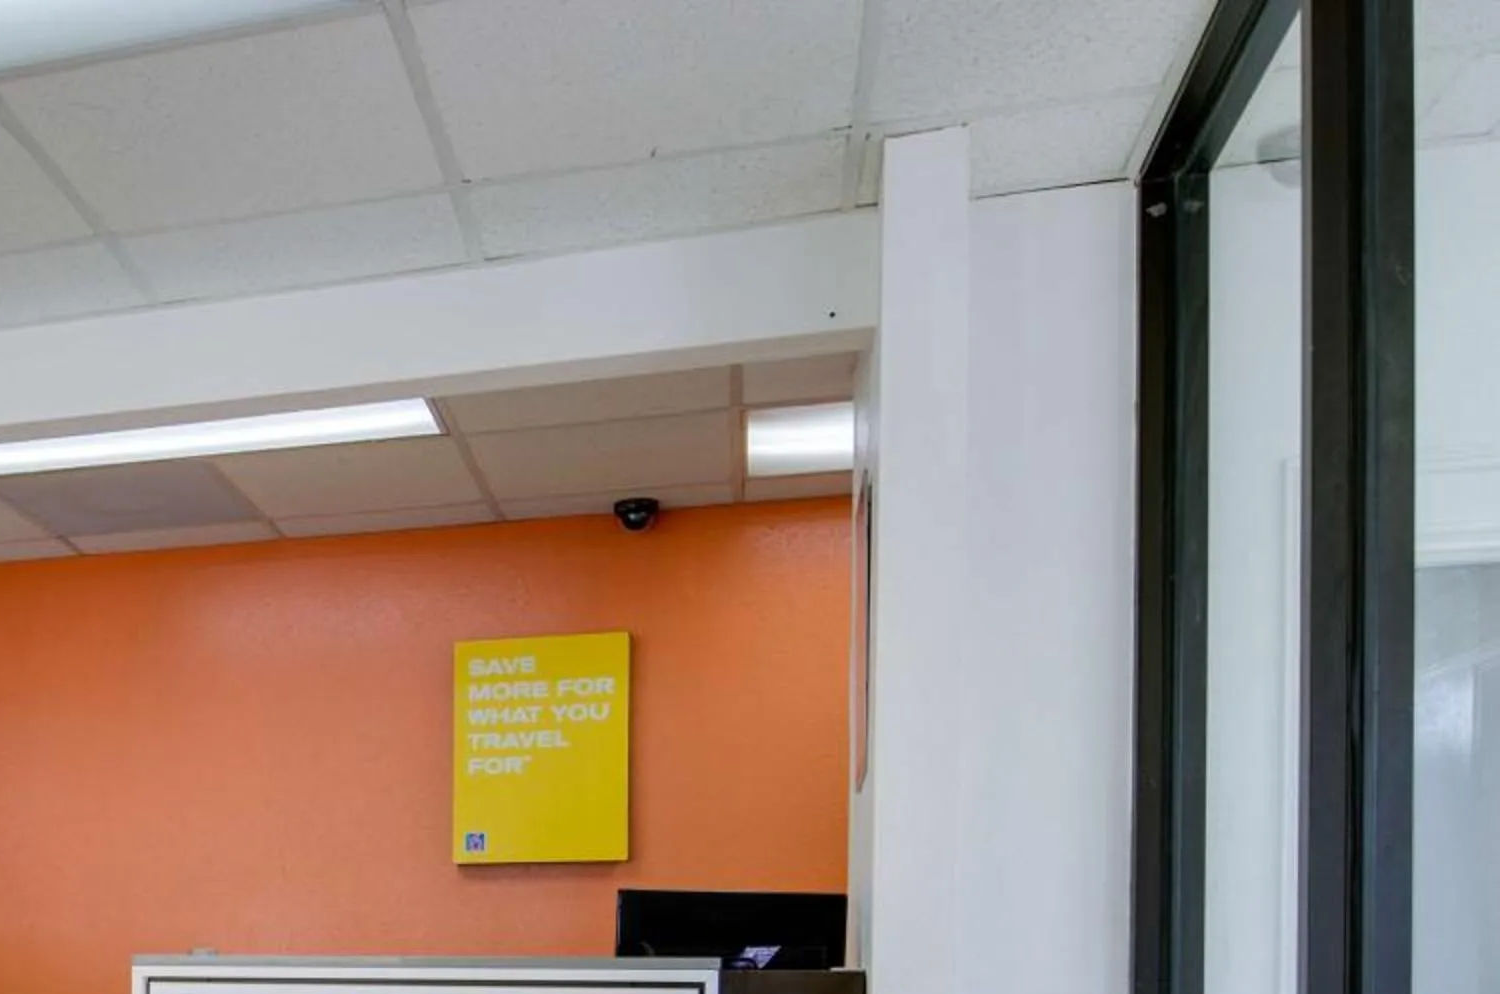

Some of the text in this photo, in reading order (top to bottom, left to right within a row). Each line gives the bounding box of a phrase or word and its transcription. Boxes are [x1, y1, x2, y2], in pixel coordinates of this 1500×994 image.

[468, 656, 535, 676] SAVE
[468, 677, 615, 700] MORE FOR
[468, 702, 612, 725] WHAT YOU
[468, 729, 570, 751] TRAVEL
